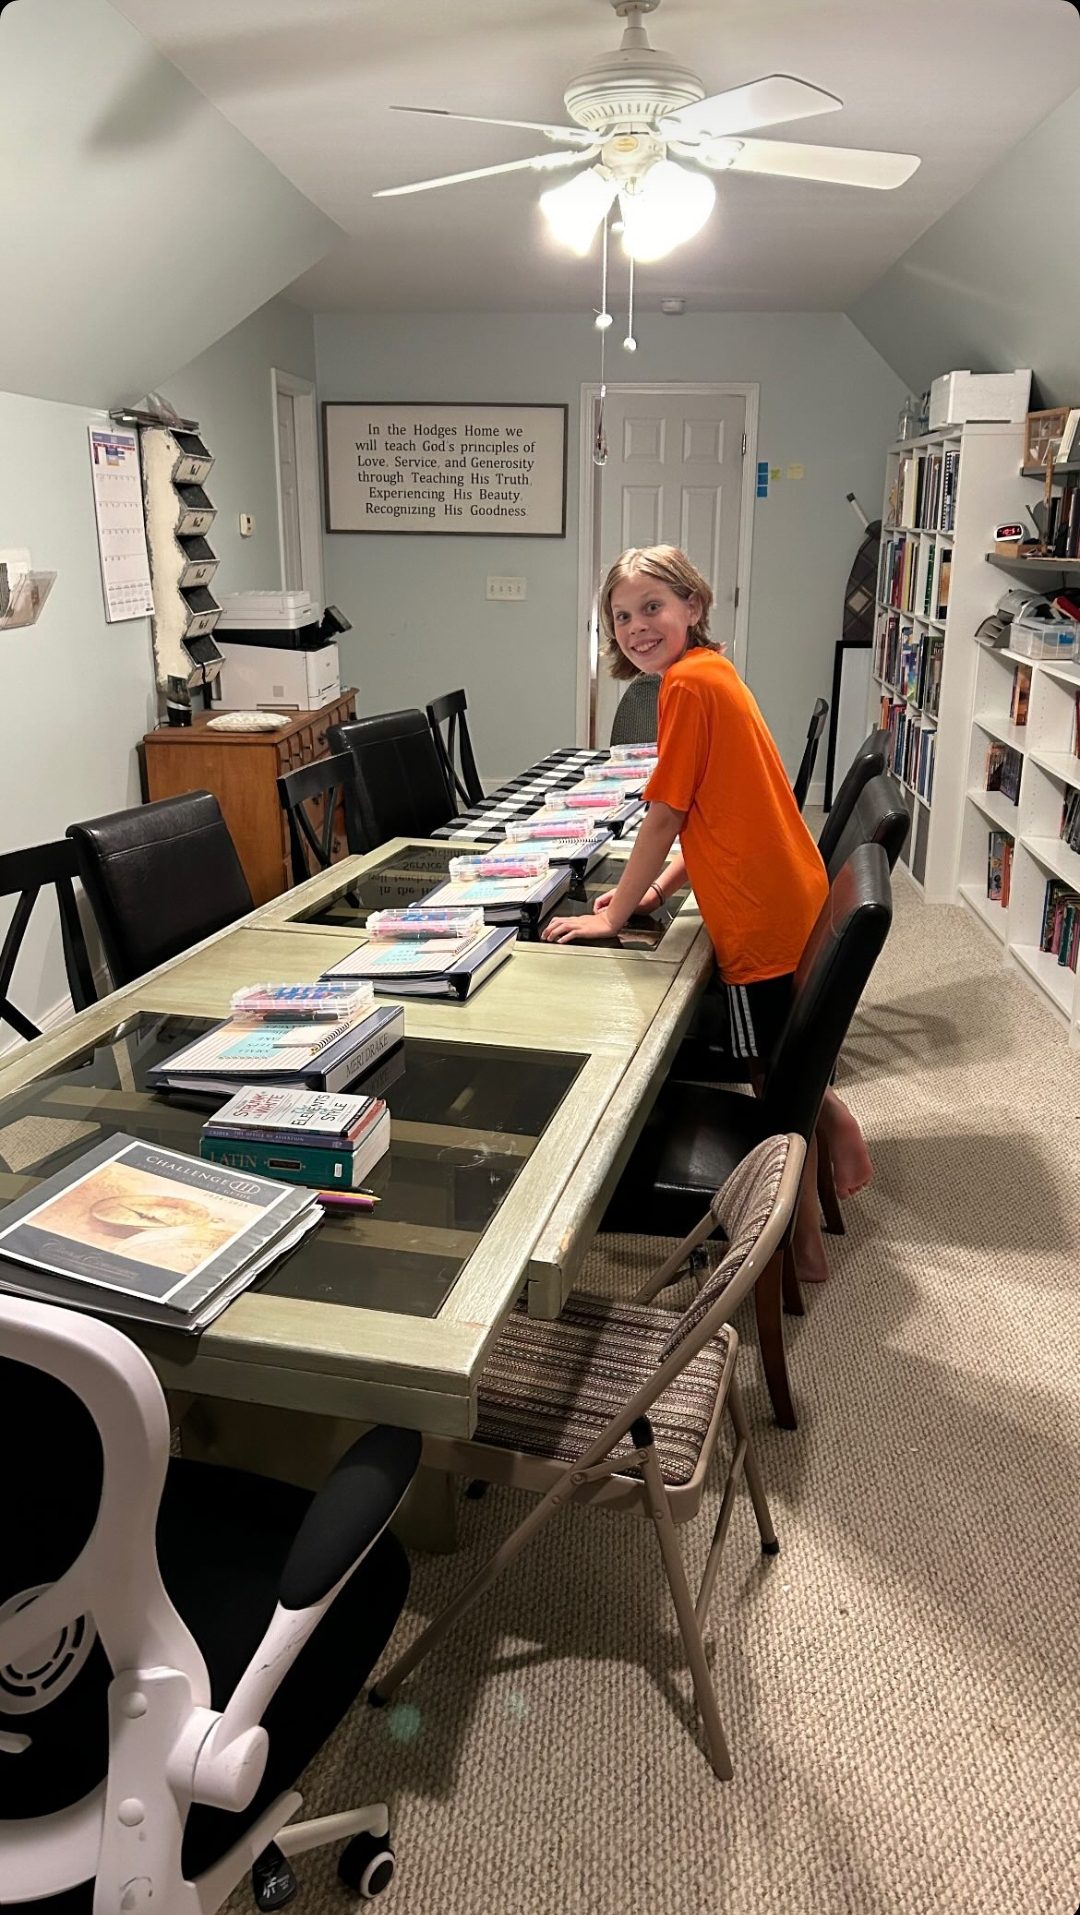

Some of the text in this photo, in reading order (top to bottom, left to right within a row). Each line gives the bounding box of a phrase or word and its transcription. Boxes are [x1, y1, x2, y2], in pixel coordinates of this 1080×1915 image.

[368, 423, 523, 439] In the Hodges Home we
[355, 439, 536, 456] will teach God's principles of
[395, 456, 440, 469] Service,
[445, 456, 466, 469] and
[471, 457, 534, 472] Generosity
[358, 471, 404, 486] through
[412, 472, 464, 487] Teaching
[471, 473, 489, 485] His
[369, 486, 445, 503] Experiencing
[454, 489, 472, 500] His
[366, 502, 436, 518] Recognizing
[444, 504, 463, 516] His
[365, 1033, 389, 1061] DRAKE
[291, 1094, 330, 1126] ELEMENTS
[321, 1102, 347, 1121] STYLE
[146, 1156, 227, 1186] CHALLENGE
